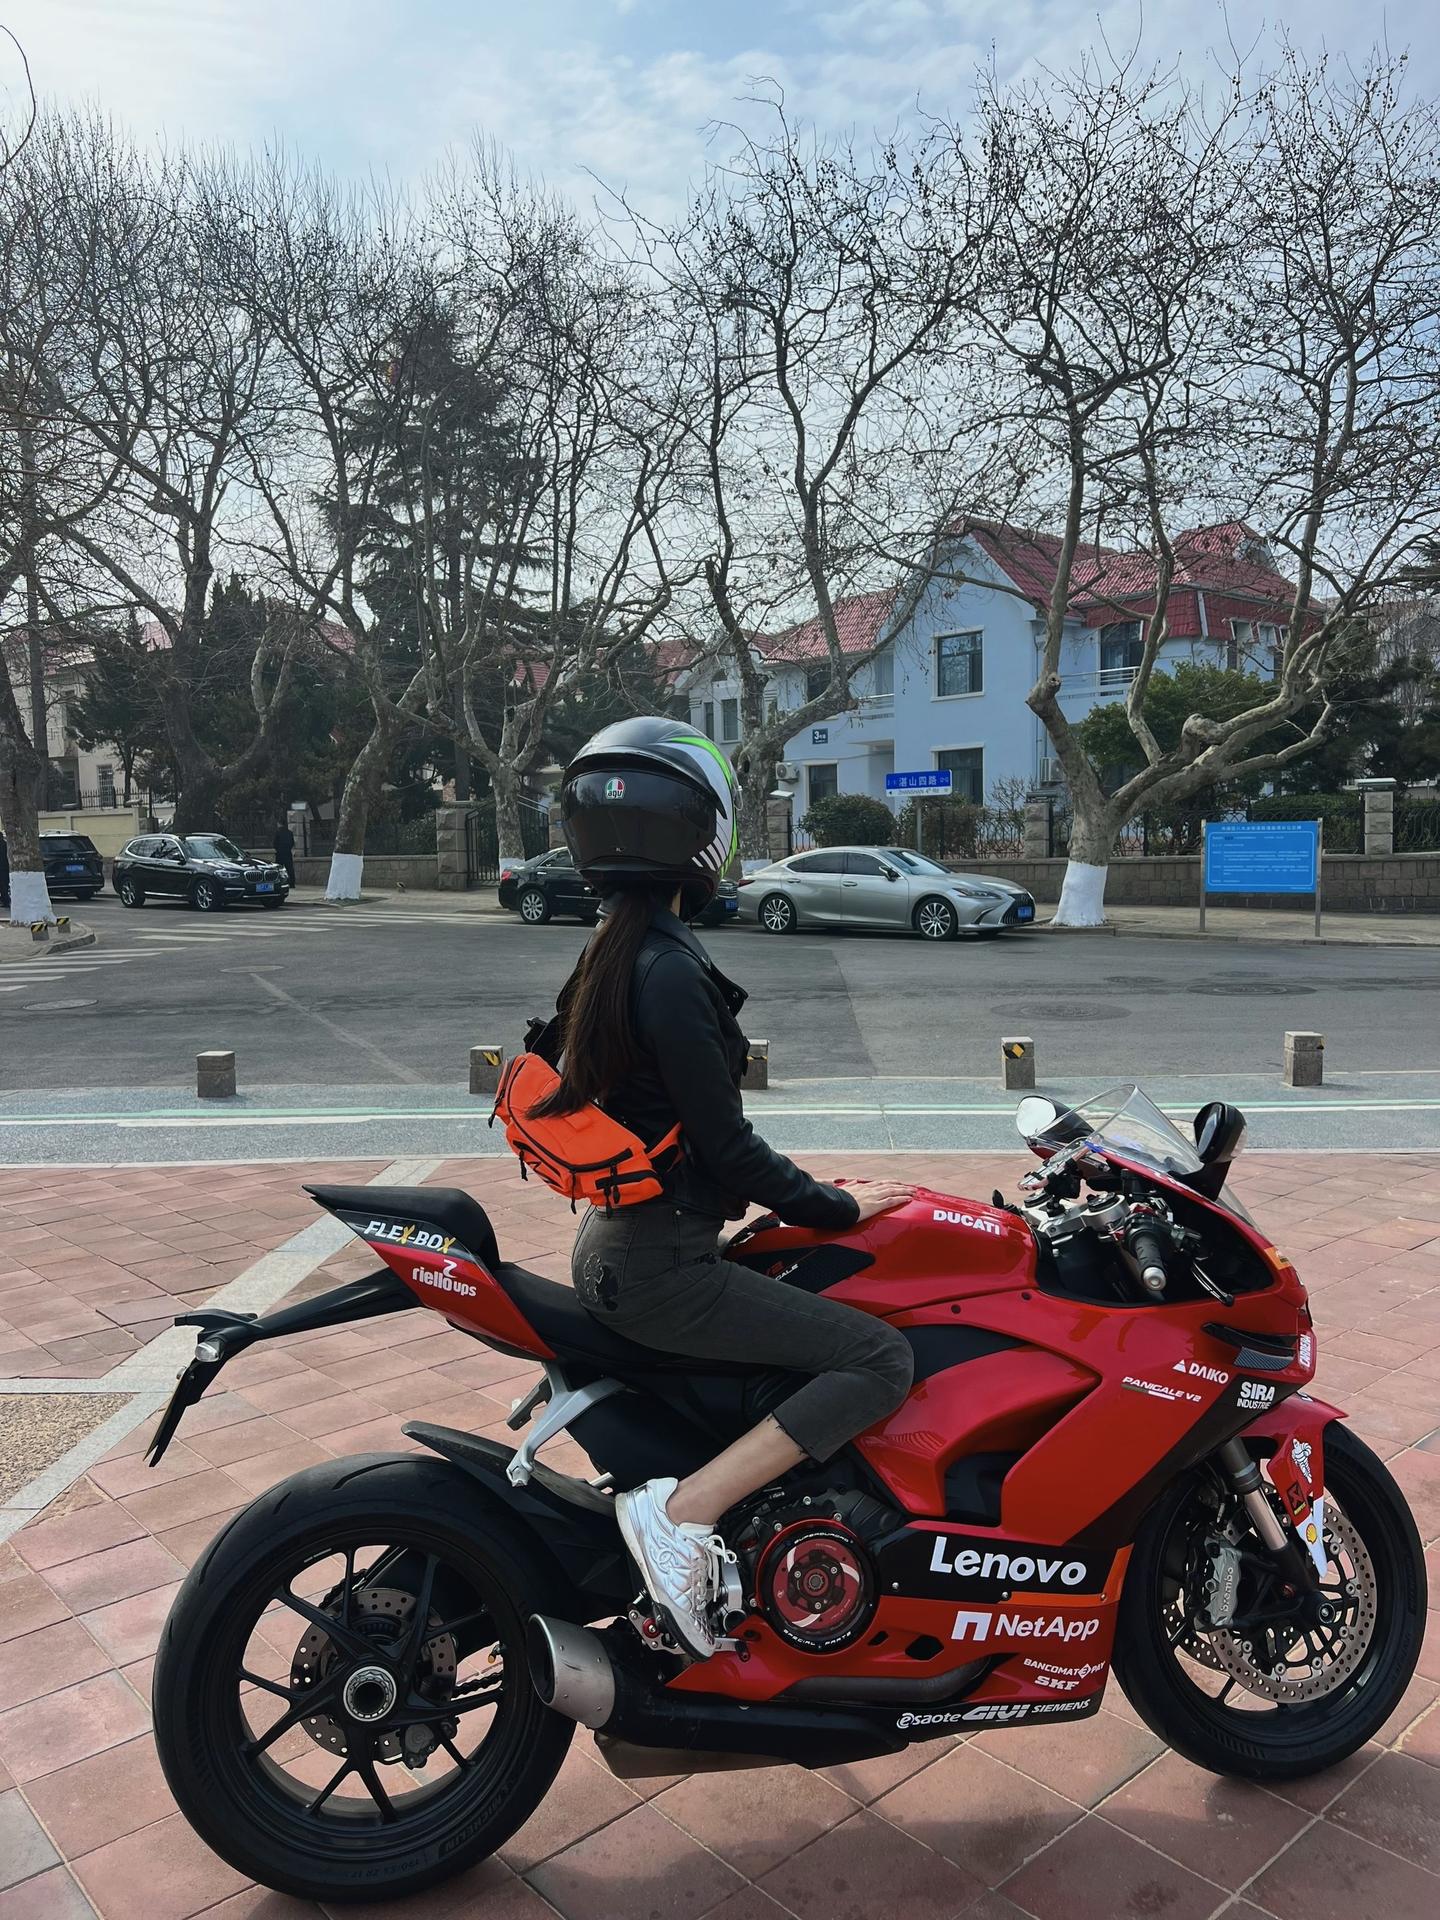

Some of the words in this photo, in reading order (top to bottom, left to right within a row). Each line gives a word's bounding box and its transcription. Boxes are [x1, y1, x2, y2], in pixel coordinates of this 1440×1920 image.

[933, 1209, 1000, 1236] DUCATI
[363, 1220, 457, 1254] FLEX-BOX
[412, 1266, 452, 1292] riello
[453, 1281, 477, 1297] ups
[1188, 1362, 1229, 1384] DAIKO
[1122, 1376, 1184, 1398] PANIGALE
[1185, 1392, 1202, 1402] V2
[1240, 1381, 1275, 1402] SIRA
[1236, 1398, 1272, 1410] INDUSTRIE
[929, 1535, 1087, 1586] Lenovo
[1220, 1567, 1234, 1611] brembo
[994, 1613, 1100, 1642] NetApp
[1023, 1658, 1080, 1676] BANCOMAT
[1034, 1675, 1080, 1691] SKF
[961, 1704, 1031, 1722] GIVI
[1031, 1698, 1091, 1714] SIEMENS
